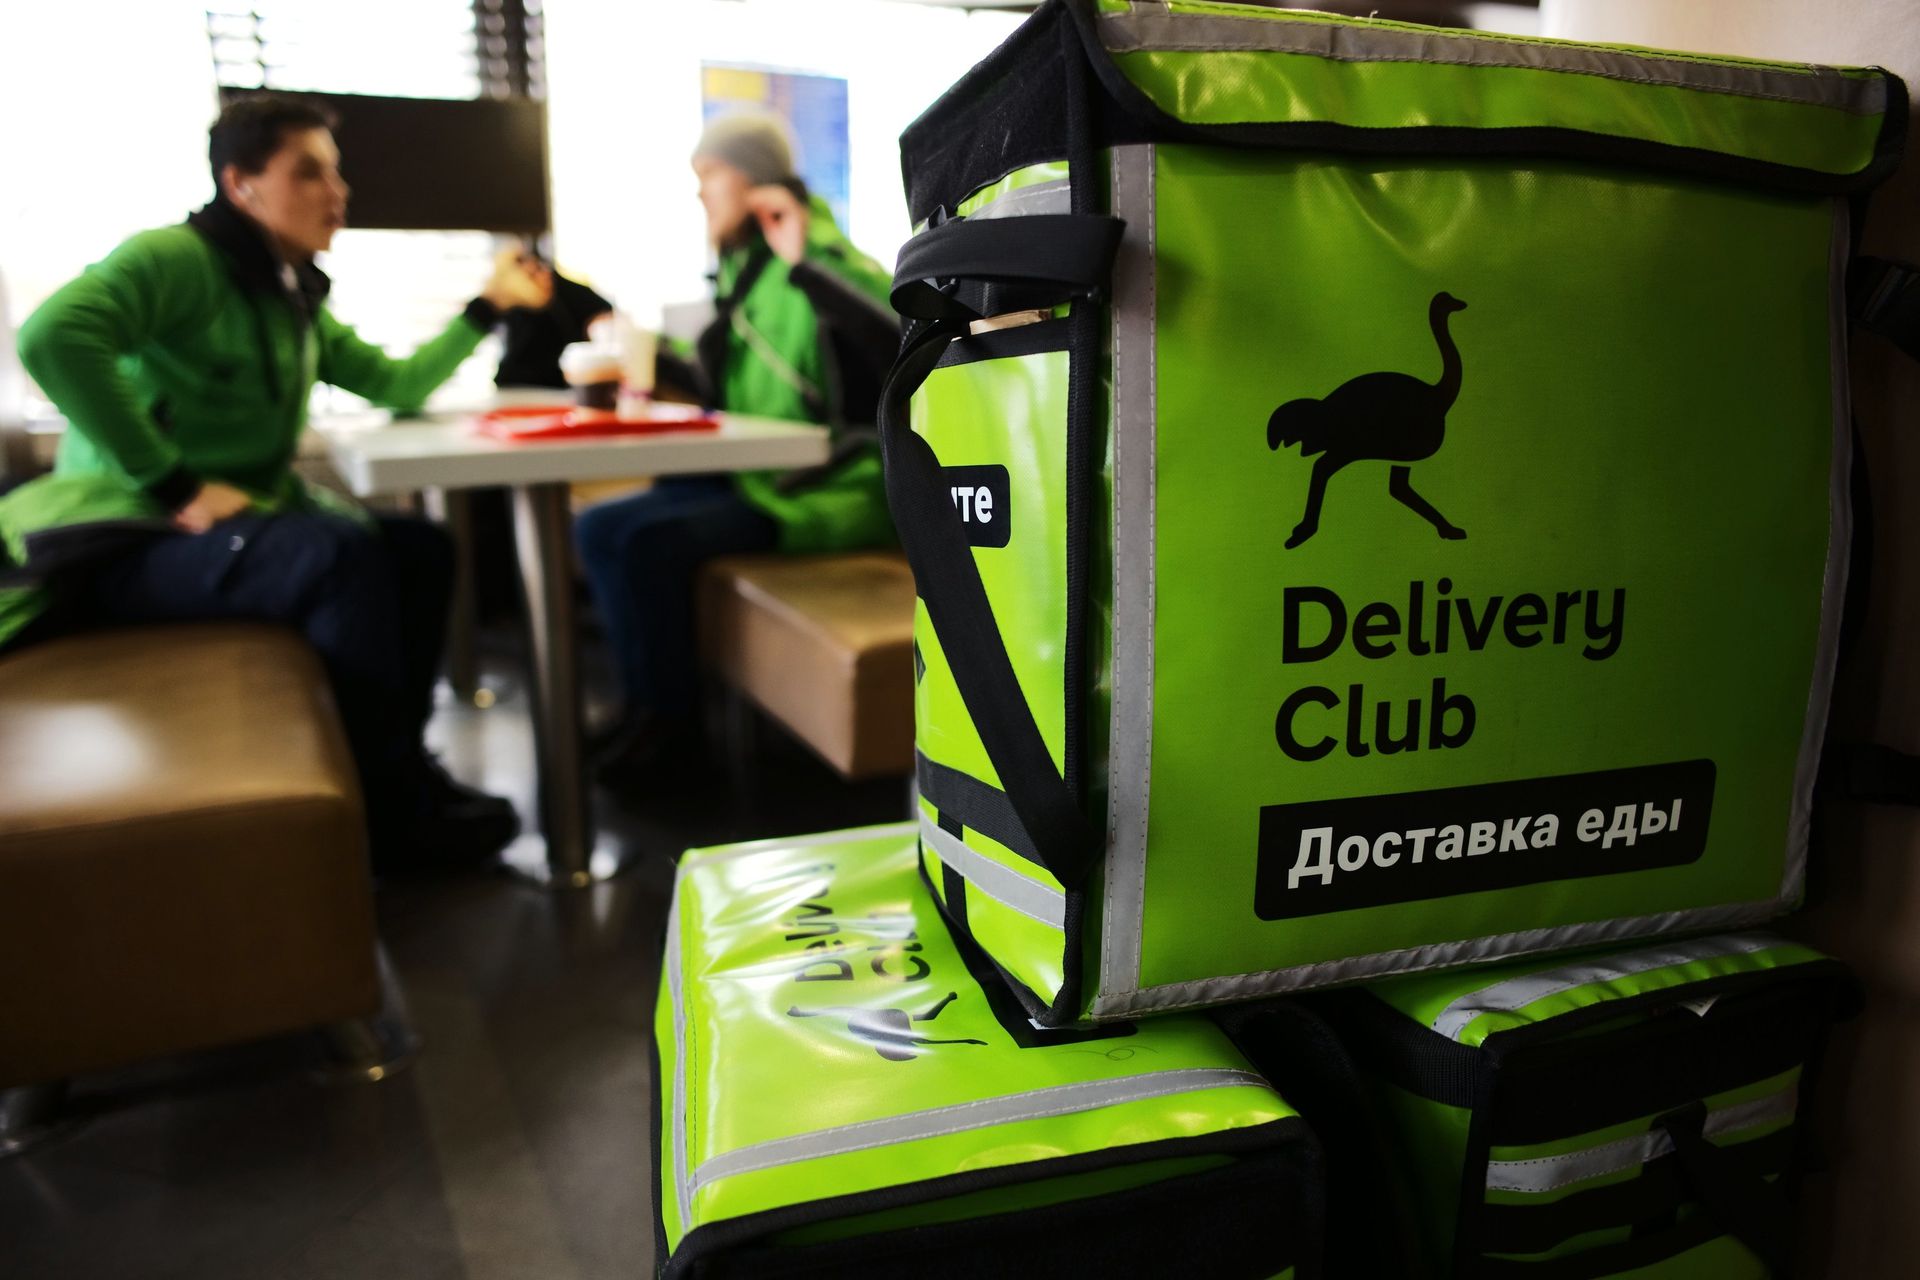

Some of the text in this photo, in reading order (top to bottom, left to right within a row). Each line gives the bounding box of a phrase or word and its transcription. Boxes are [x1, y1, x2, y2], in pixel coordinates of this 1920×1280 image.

[1282, 577, 1626, 664] Delivery
[1275, 677, 1476, 762] Club
[1287, 798, 1683, 889] Доставка еды
